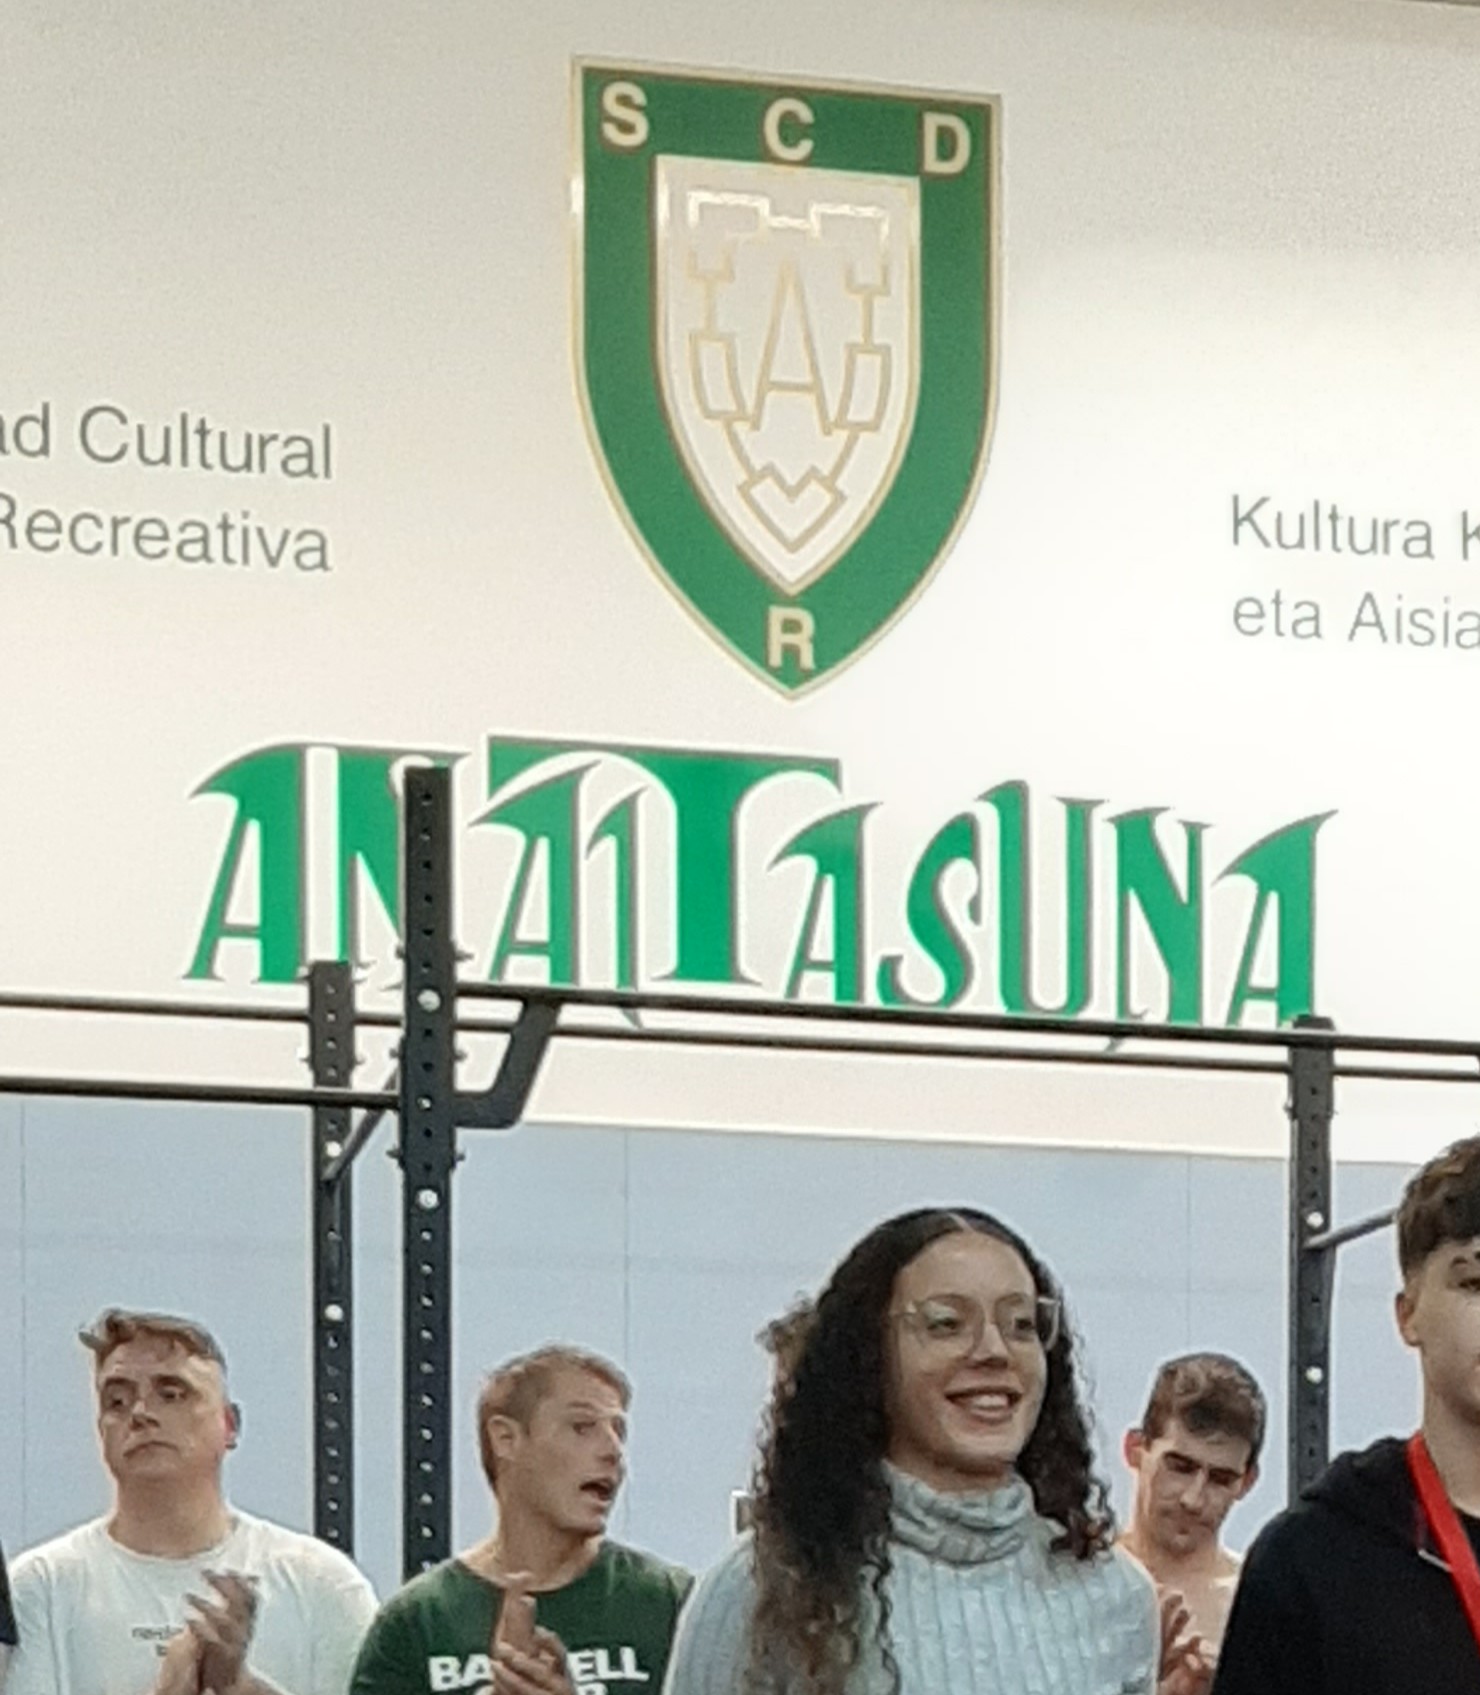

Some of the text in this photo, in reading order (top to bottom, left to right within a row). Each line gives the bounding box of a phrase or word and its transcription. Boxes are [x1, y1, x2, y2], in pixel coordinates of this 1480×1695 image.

[602, 83, 971, 174] S C D
[79, 404, 333, 480] Cultural
[1231, 494, 1436, 560] Kultura
[766, 605, 816, 673] R
[1232, 589, 1323, 640] eta
[428, 1645, 650, 1692] BAELL
